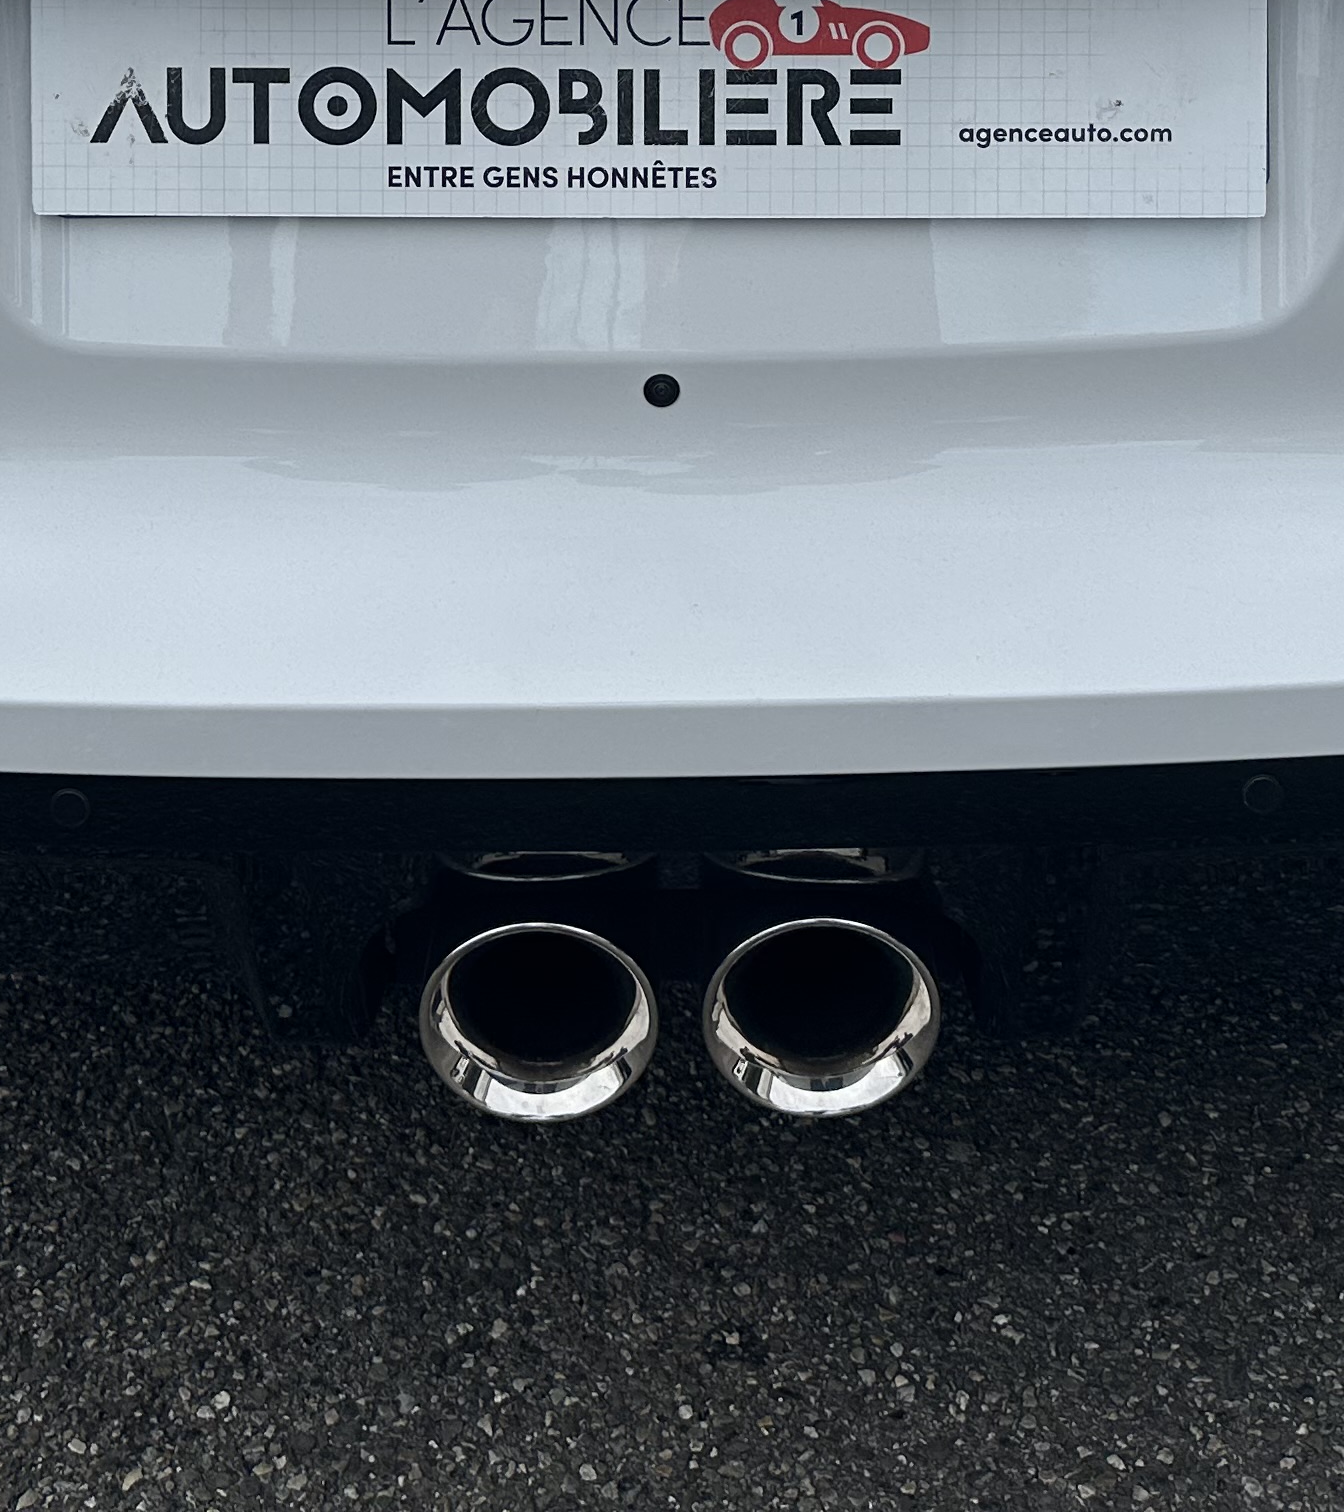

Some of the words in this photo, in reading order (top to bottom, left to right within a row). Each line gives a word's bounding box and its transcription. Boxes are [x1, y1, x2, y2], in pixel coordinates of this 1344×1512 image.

[958, 123, 1173, 149] agenceauto.com
[387, 165, 475, 189] ENTRE
[482, 165, 559, 190] GENS
[566, 159, 718, 190] HONNÊTES
